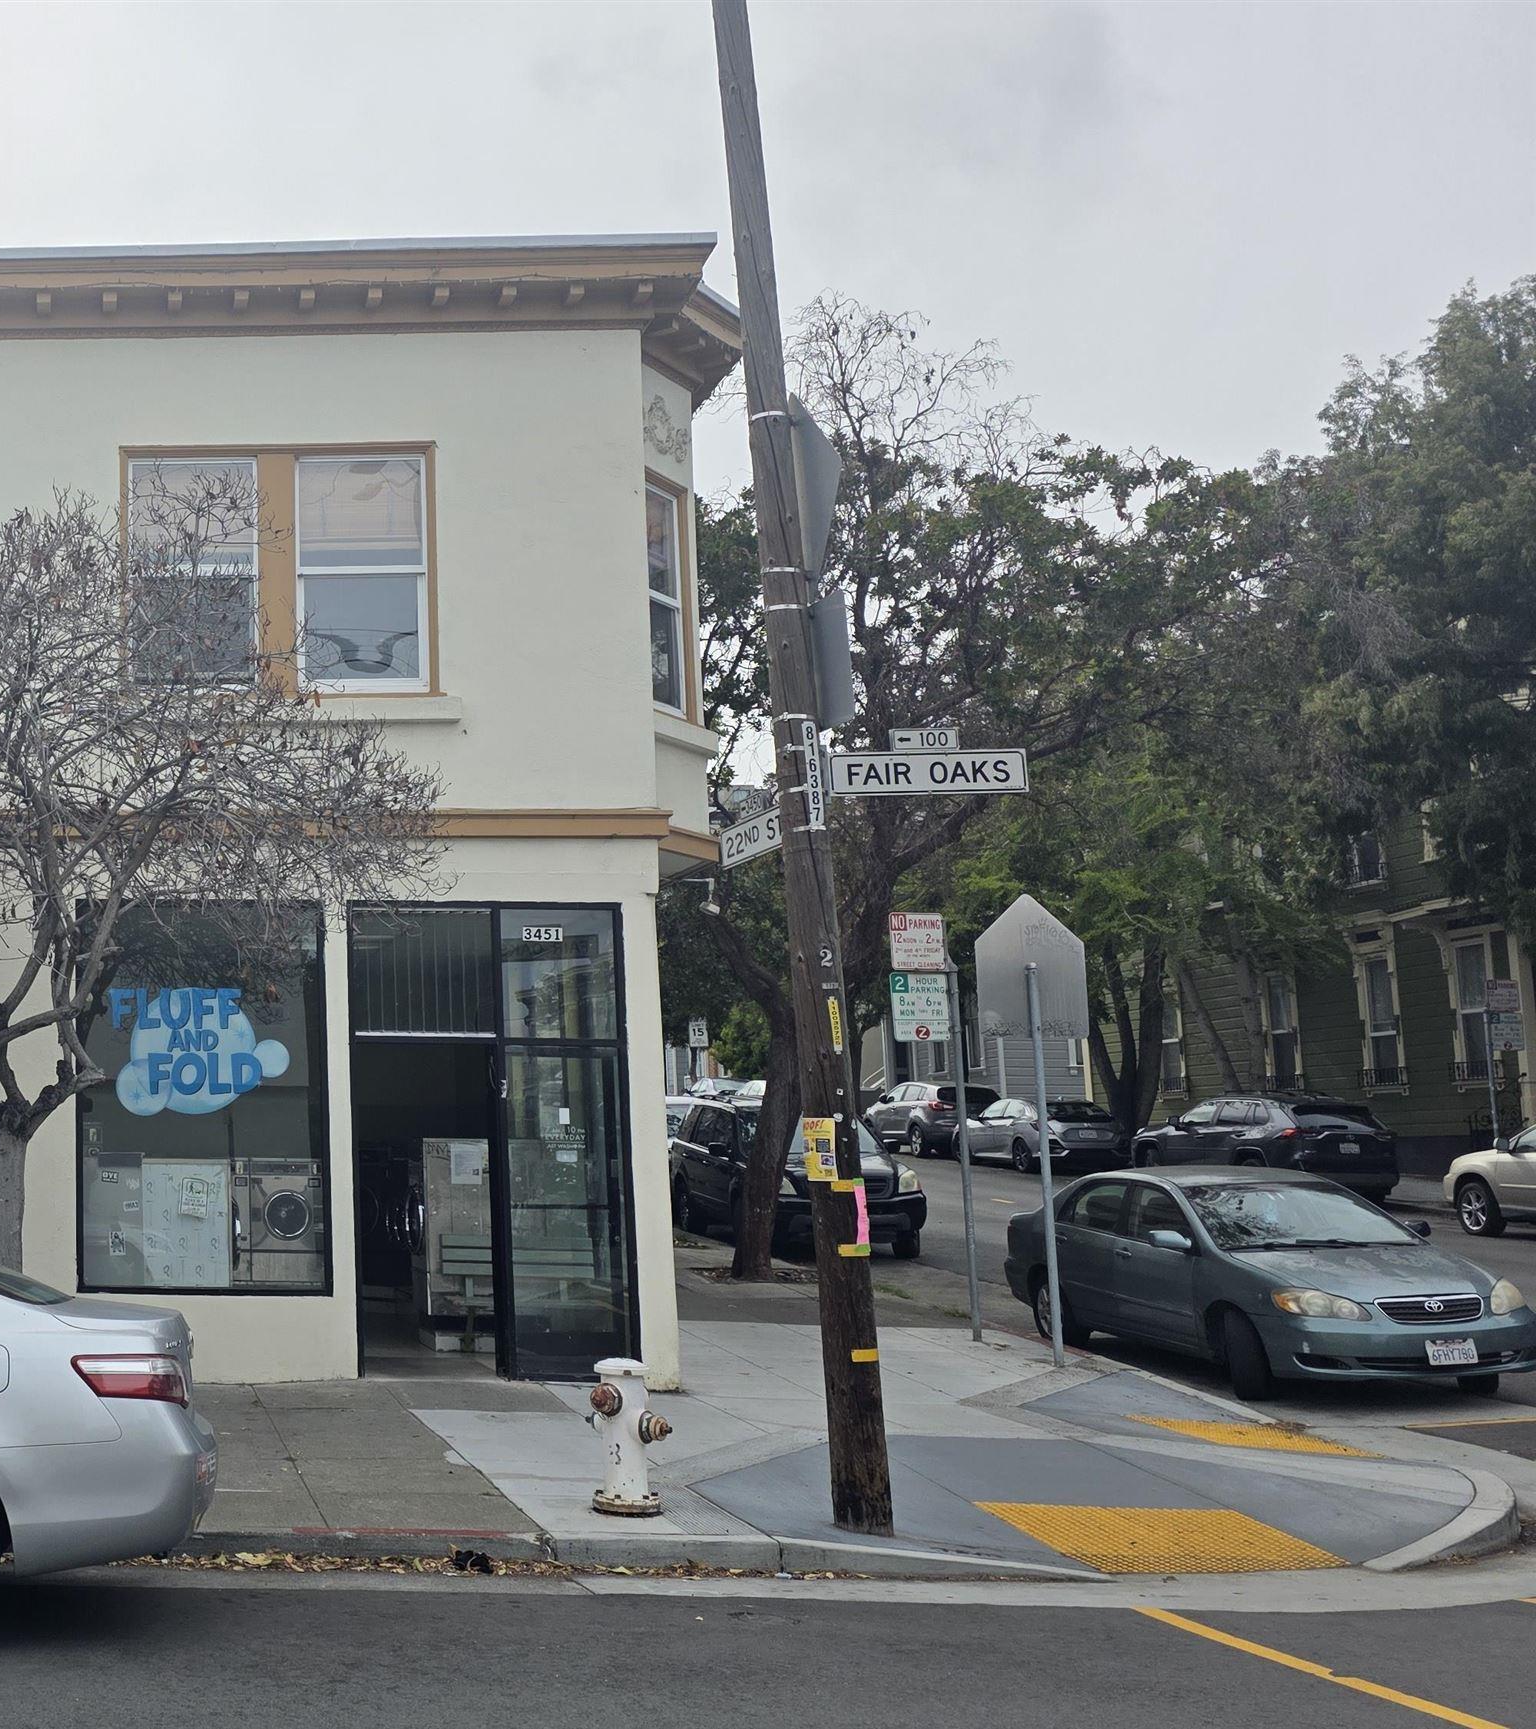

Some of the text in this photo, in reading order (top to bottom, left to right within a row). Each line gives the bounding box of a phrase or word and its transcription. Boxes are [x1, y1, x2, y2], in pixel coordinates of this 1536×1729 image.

[919, 731, 948, 746] 100
[846, 760, 1011, 786] FAIR OAKS
[725, 825, 760, 859] 22ND
[891, 915, 941, 930] NO PARKING
[524, 928, 561, 940] 3451
[893, 932, 902, 943] 12
[925, 933, 932, 944] 2
[819, 949, 833, 967] 2
[895, 976, 905, 990] 2
[107, 986, 242, 1031] FLUFF
[899, 996, 905, 1006] 8
[925, 996, 932, 1006] 6
[692, 1028, 704, 1036] 15
[918, 1027, 928, 1038] Z
[166, 1029, 219, 1052] AND
[147, 1052, 264, 1096] FOLD
